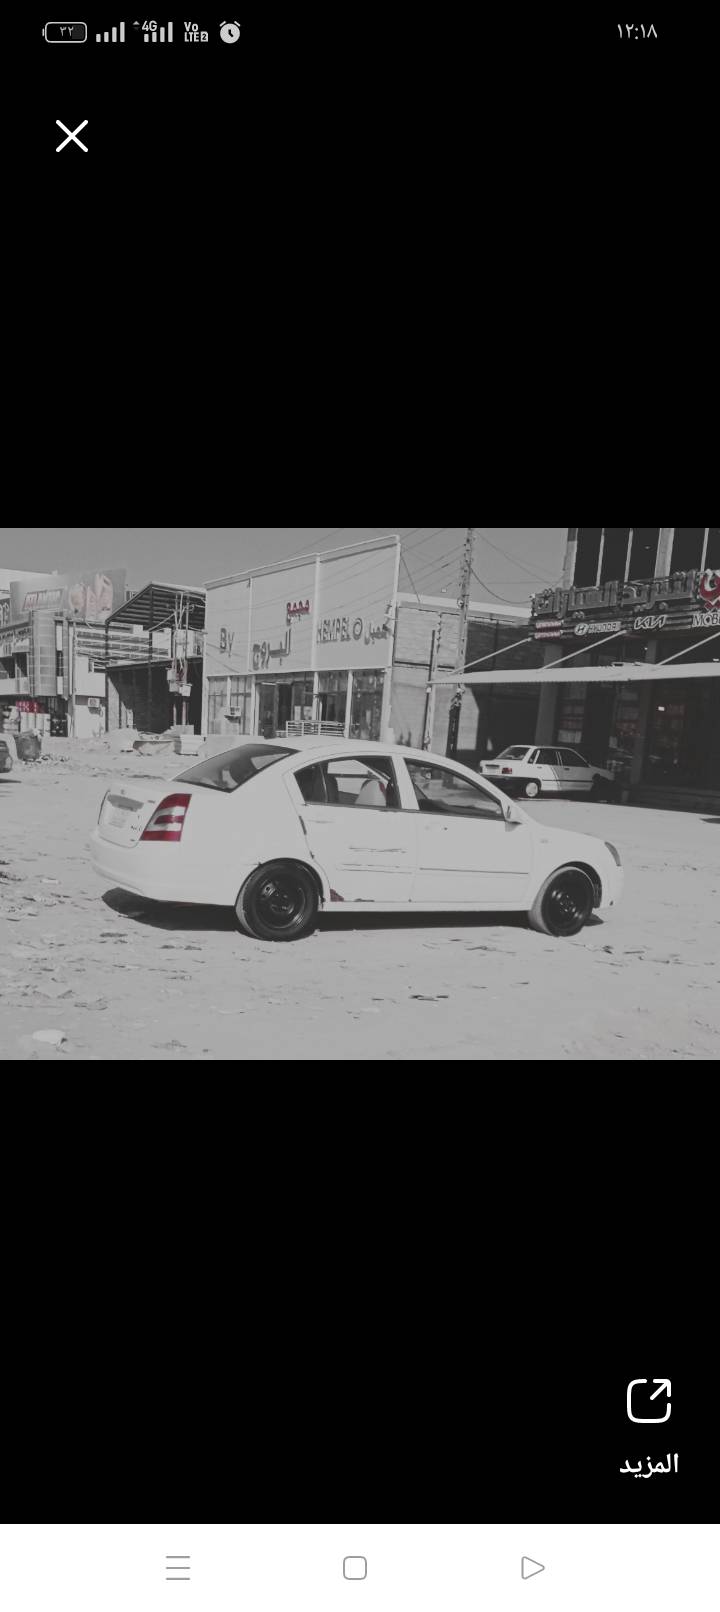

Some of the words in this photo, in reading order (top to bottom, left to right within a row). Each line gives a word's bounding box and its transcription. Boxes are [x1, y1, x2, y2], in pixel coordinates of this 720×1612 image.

[633, 614, 667, 630] KIA
[692, 612, 720, 627] MOB
[316, 617, 351, 644] HEMPEL
